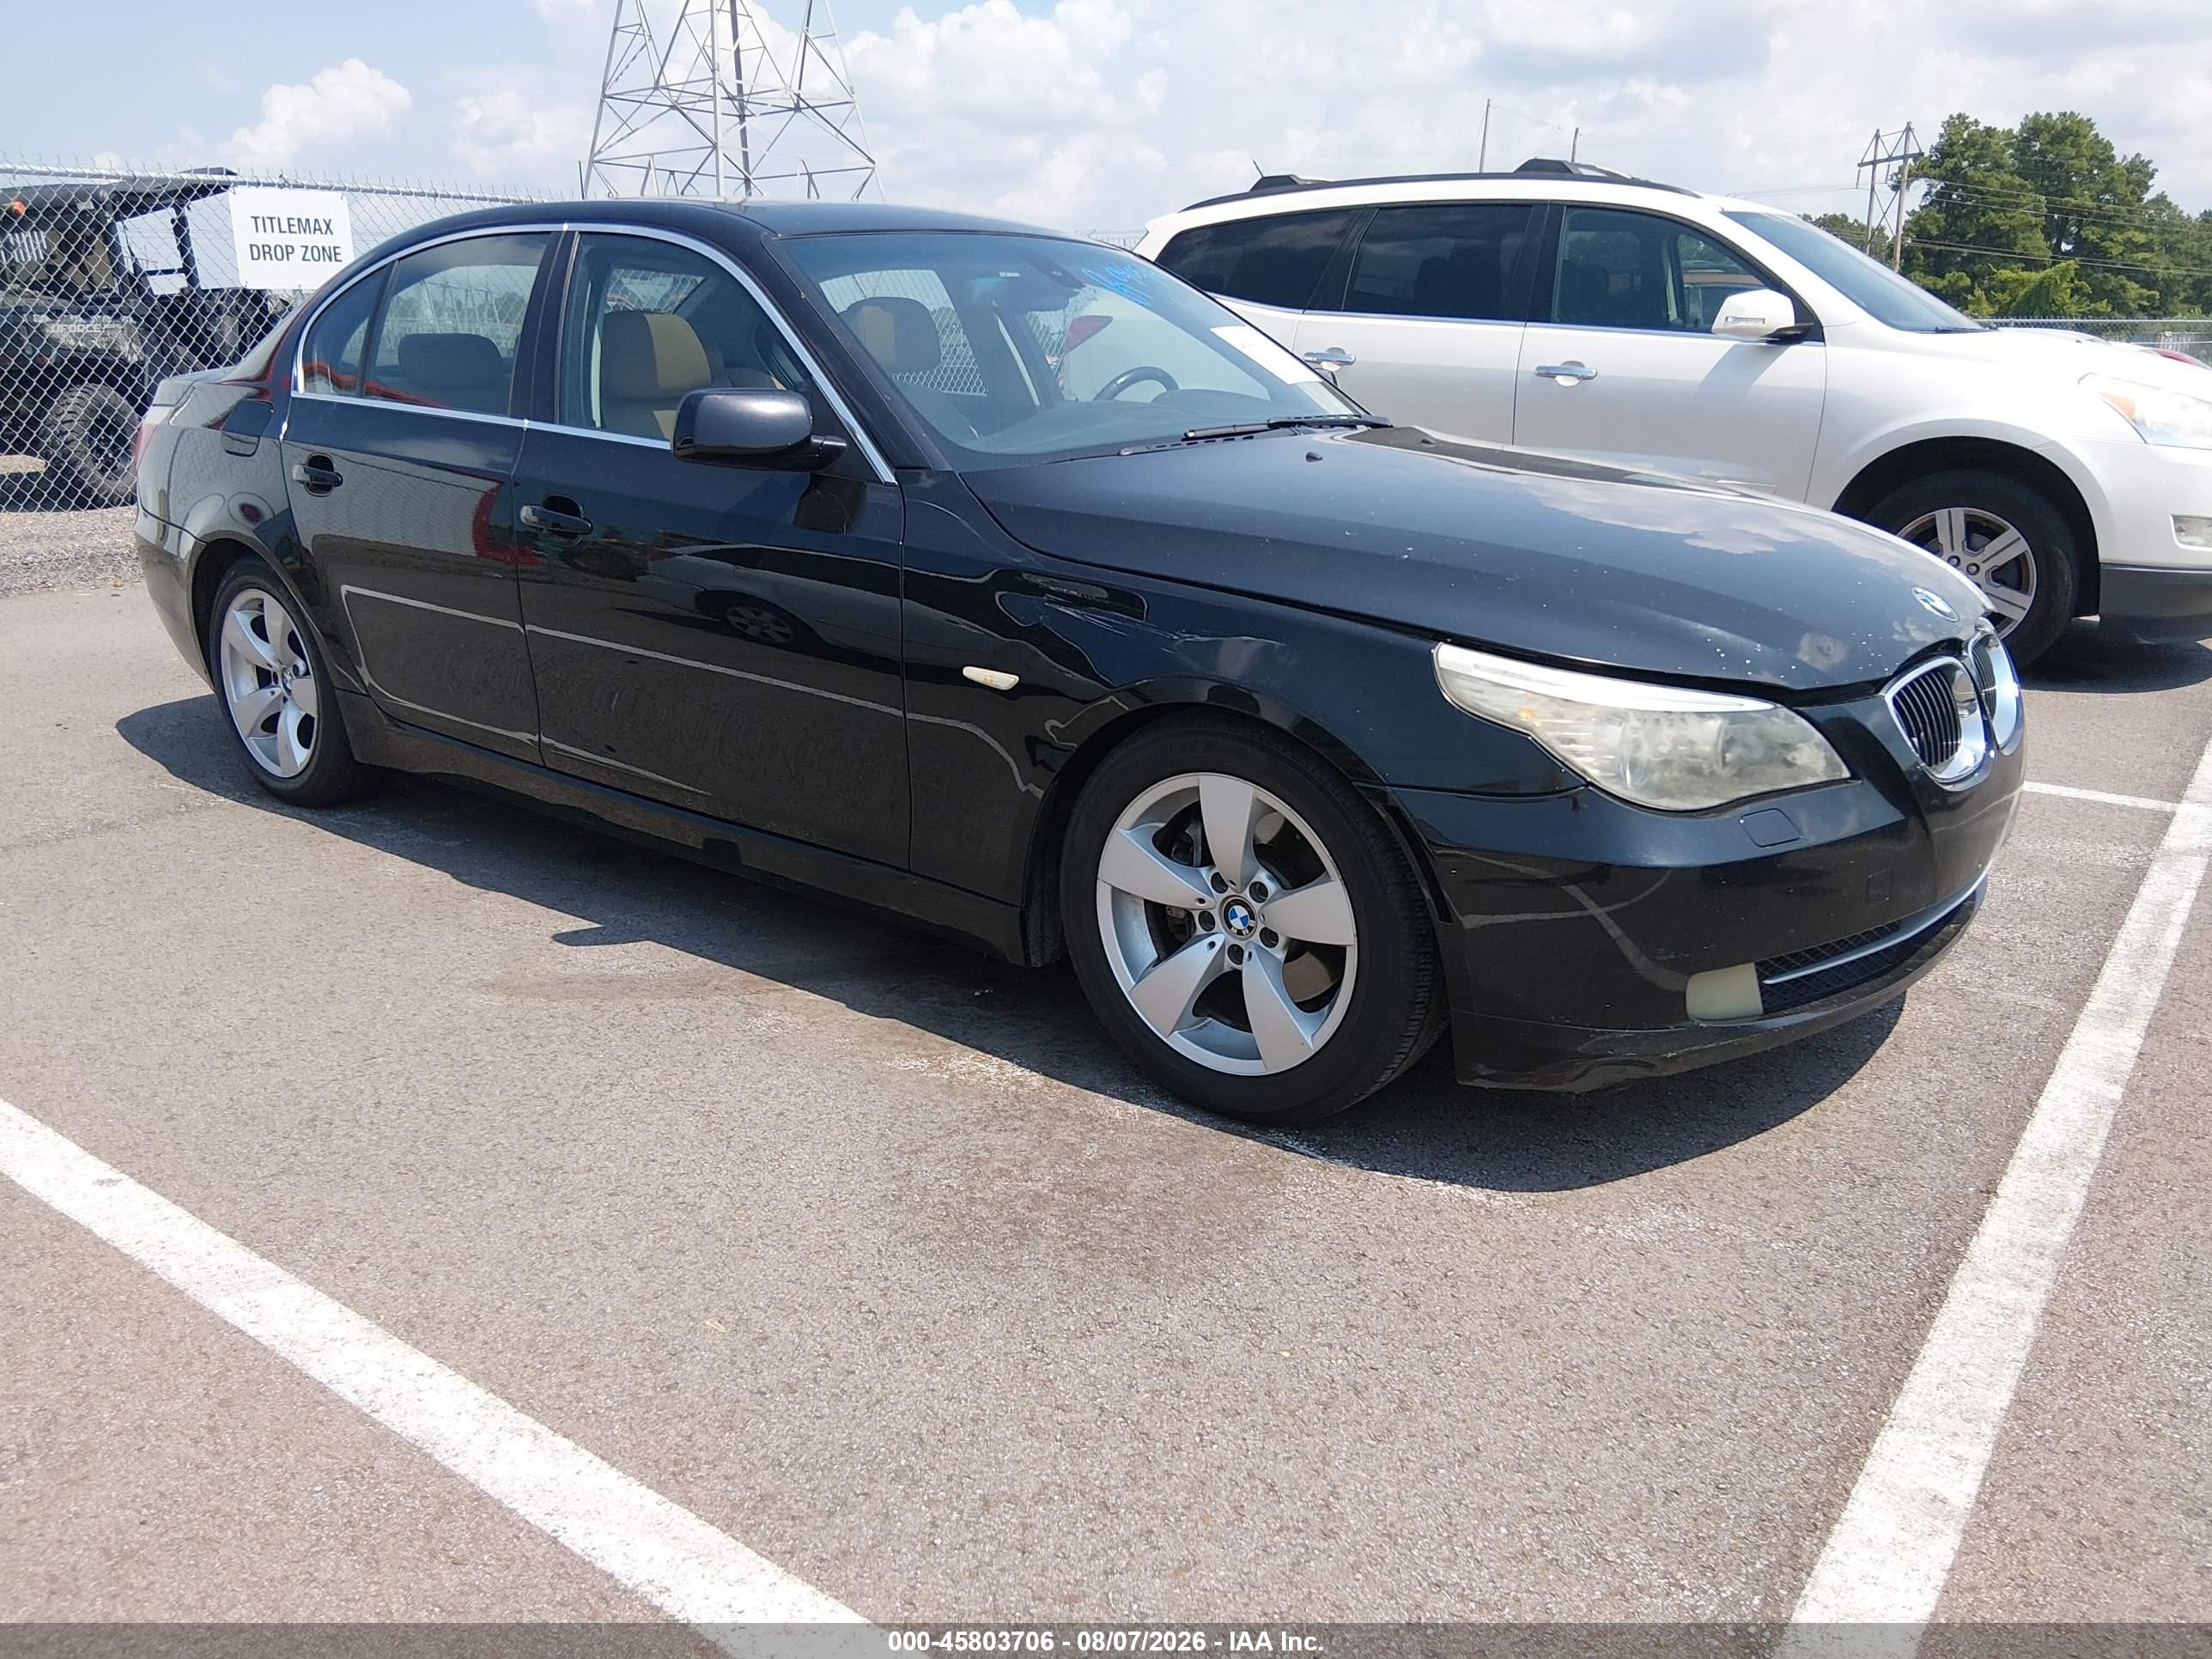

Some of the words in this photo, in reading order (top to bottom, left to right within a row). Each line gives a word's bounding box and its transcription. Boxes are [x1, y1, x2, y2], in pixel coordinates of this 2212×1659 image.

[250, 216, 334, 235] TITLEMAX
[249, 243, 295, 261] DROP
[301, 245, 343, 263] ZONE
